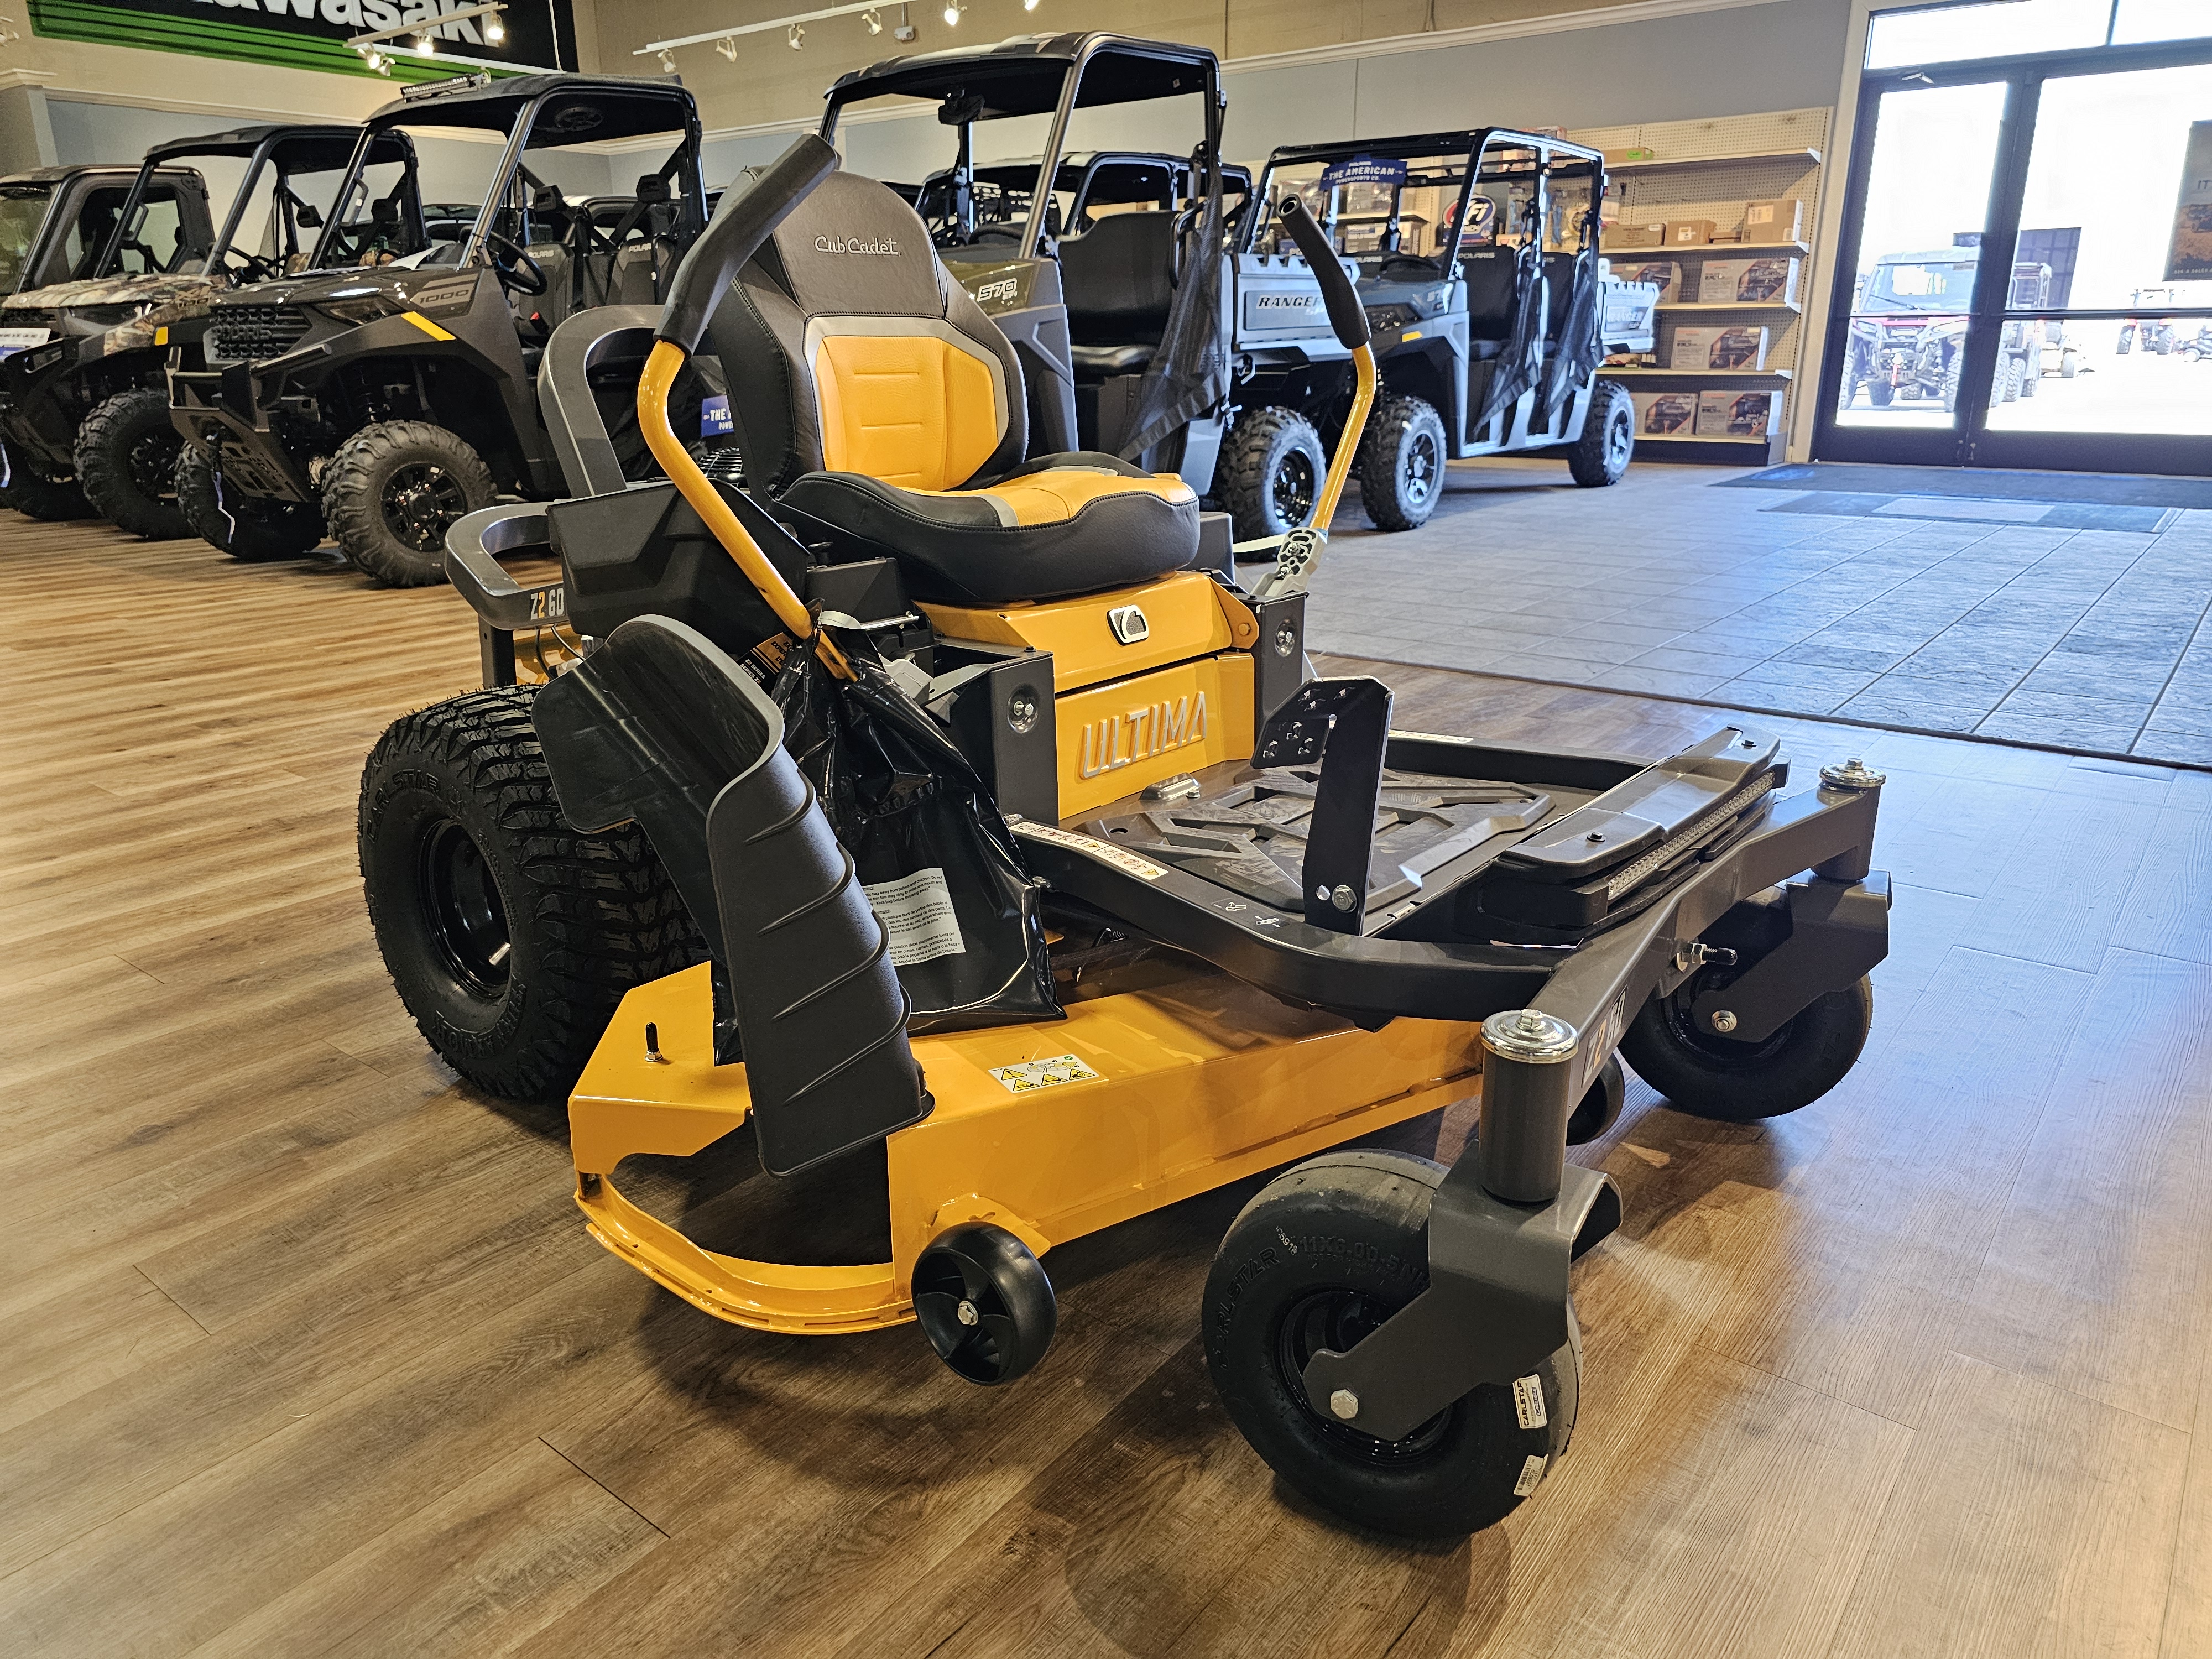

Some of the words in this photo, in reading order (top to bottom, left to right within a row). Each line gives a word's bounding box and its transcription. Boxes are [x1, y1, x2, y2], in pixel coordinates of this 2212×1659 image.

[191, 0, 498, 48] asaki
[1329, 170, 1344, 181] THE
[1345, 166, 1395, 176] AMERICAN
[814, 235, 846, 254] Cub
[847, 237, 898, 255] Cadet
[1457, 251, 1495, 259] POLARIS
[420, 289, 469, 304] 1000
[977, 278, 1018, 302] 570
[1256, 295, 1324, 310] RANGER
[710, 408, 726, 422] THE
[530, 591, 545, 620] Z2
[549, 587, 564, 617] 60
[740, 664, 755, 679] SERIES
[750, 664, 766, 679] SERIES
[1081, 691, 1207, 780] ULTIMA
[905, 891, 919, 899] throwing
[1583, 1019, 1607, 1085] Z2
[1605, 990, 1626, 1051] 60
[1217, 1246, 1281, 1370] CARLSTAR
[1517, 1381, 1530, 1426] CARLSTAR
